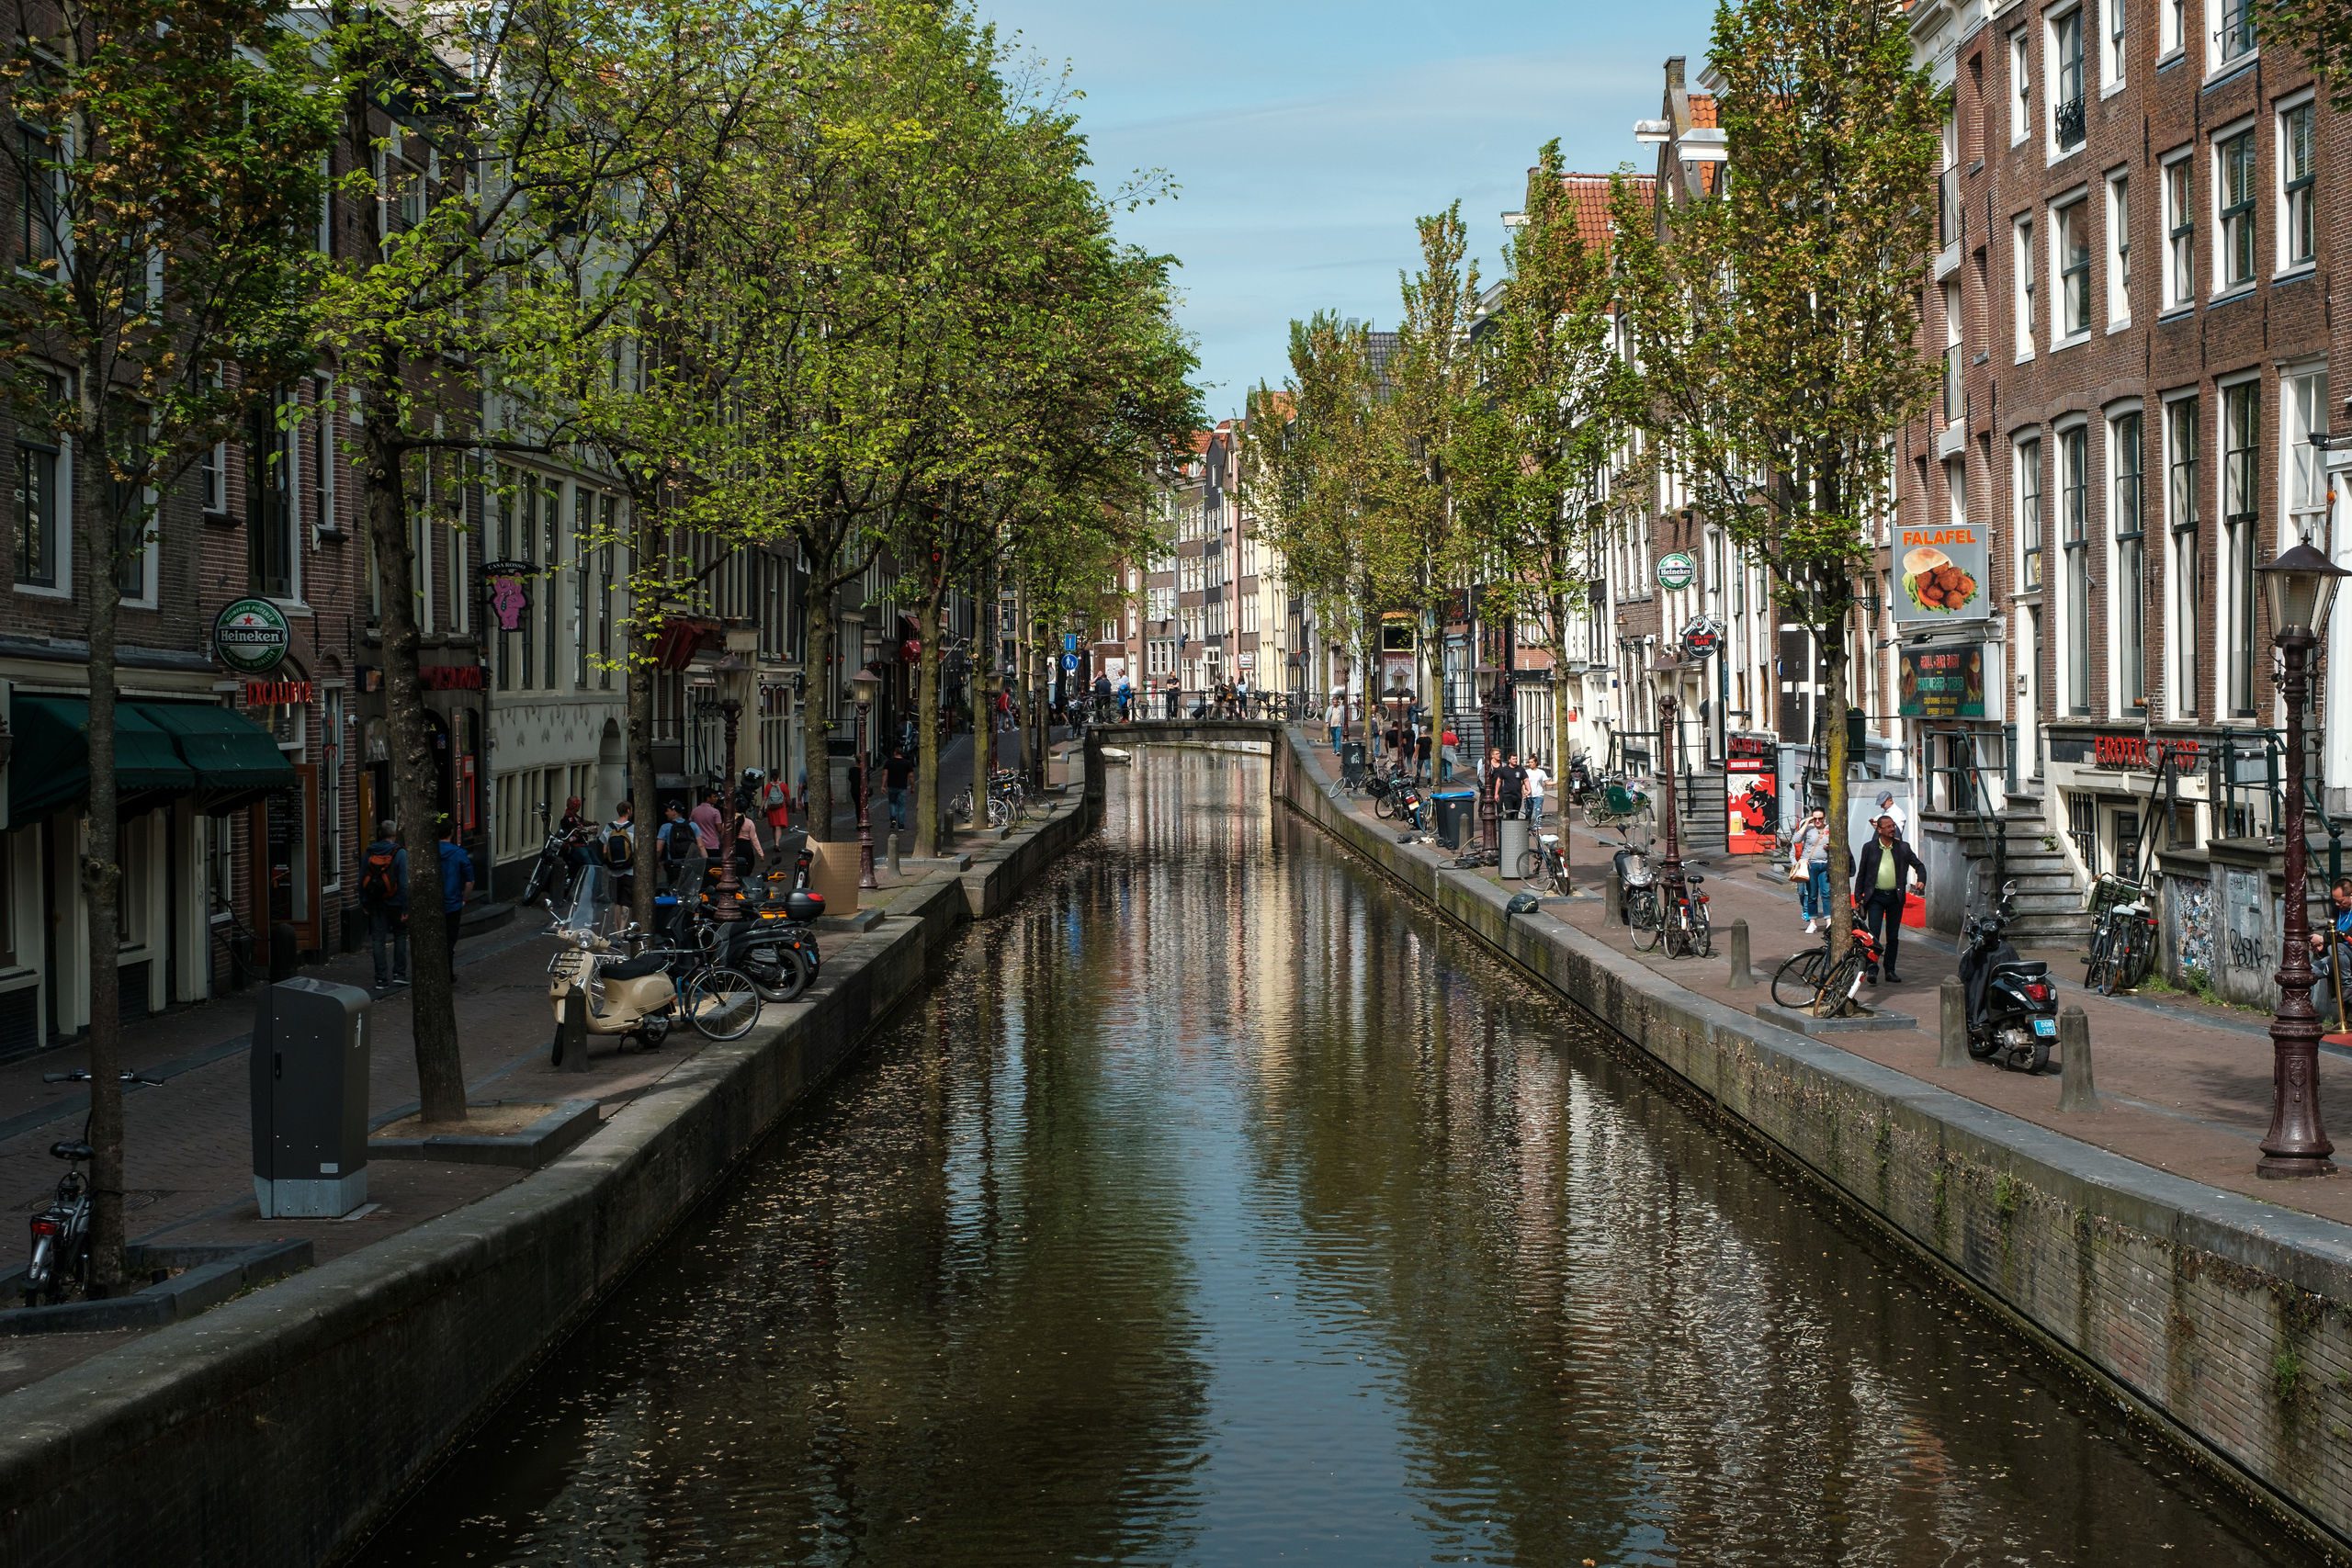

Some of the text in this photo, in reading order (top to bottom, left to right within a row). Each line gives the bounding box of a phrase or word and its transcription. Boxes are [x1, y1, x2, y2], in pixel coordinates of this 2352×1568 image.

[1903, 529, 1976, 546] FALAFEL
[1661, 568, 1691, 576] Heineken
[220, 629, 280, 642] Heineken
[247, 682, 312, 705] EXCALIBUR
[2095, 737, 2151, 766] EROTIC
